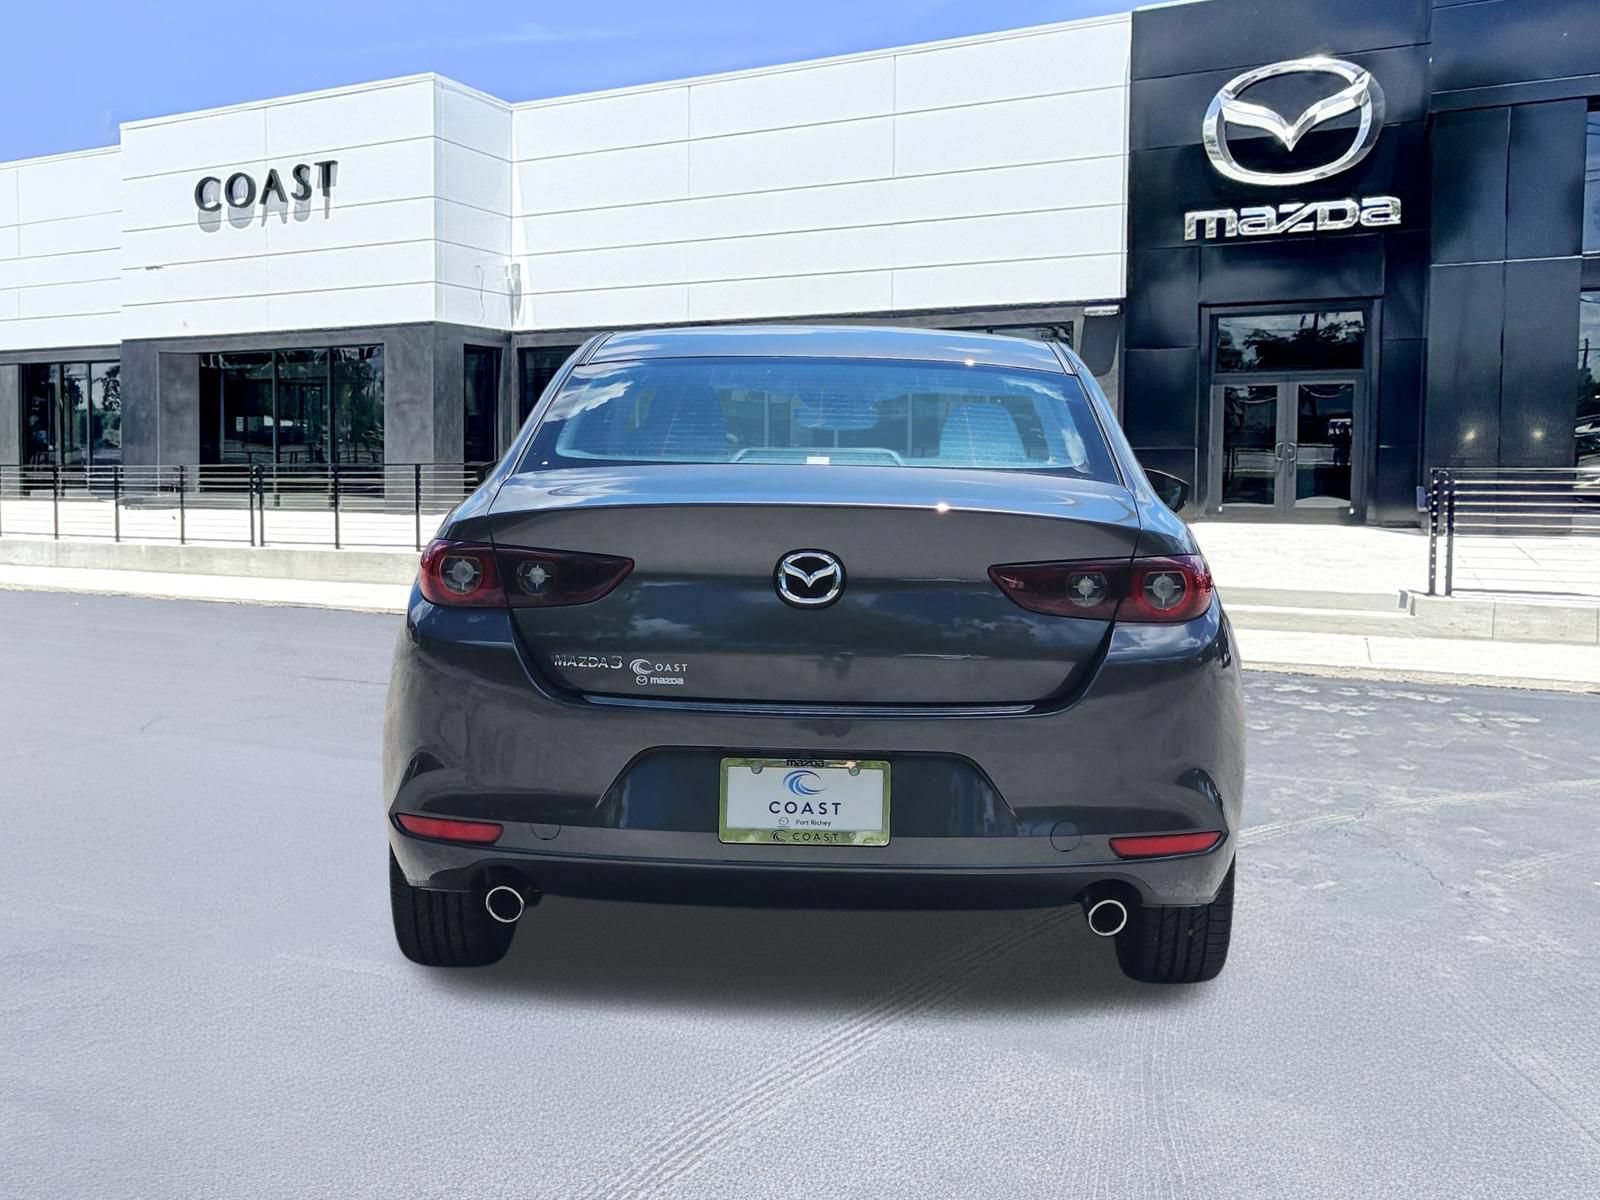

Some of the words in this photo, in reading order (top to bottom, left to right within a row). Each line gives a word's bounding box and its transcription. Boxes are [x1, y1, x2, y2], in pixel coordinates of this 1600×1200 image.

[194, 160, 338, 212] COAST
[1184, 196, 1402, 241] mazda
[650, 676, 684, 685] mazda
[768, 801, 842, 815] COAST
[811, 819, 832, 827] Richey
[792, 832, 838, 842] COAST
